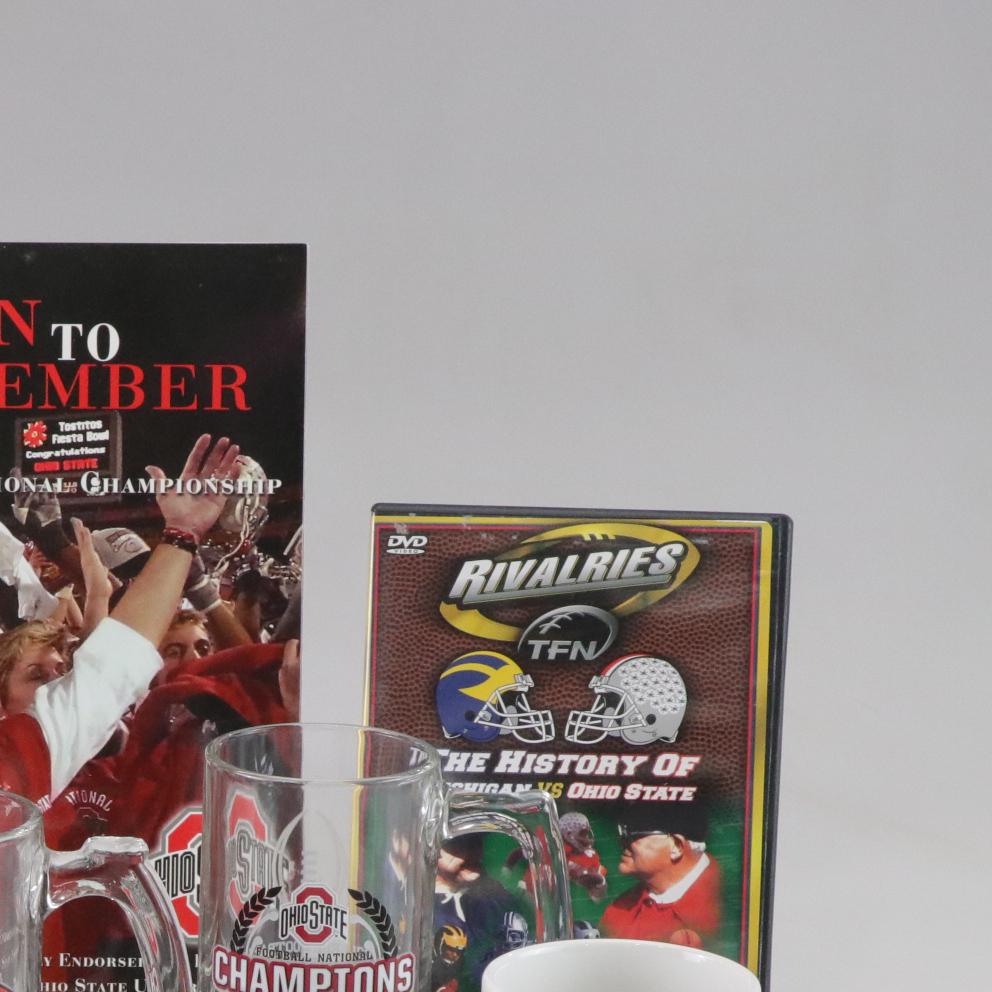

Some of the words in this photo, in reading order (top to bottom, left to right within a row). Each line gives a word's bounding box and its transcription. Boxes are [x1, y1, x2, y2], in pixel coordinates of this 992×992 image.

[51, 322, 120, 362] TO
[52, 433, 83, 444] Fiesta
[86, 430, 109, 442] Bowl
[26, 447, 106, 459] Congratulations
[80, 470, 283, 496] CHAMPIONSHIP
[388, 535, 428, 549] DVD
[449, 542, 685, 600] RIVALRIES
[527, 639, 598, 661] TFN
[494, 749, 648, 777] HISTORY
[653, 754, 702, 777] OF
[537, 782, 563, 798] VS
[567, 782, 621, 800] OHIO
[624, 783, 697, 802] STATE
[256, 947, 312, 962] FOOTBALL
[318, 951, 373, 962] NATIONAL
[75, 978, 127, 992] STATE
